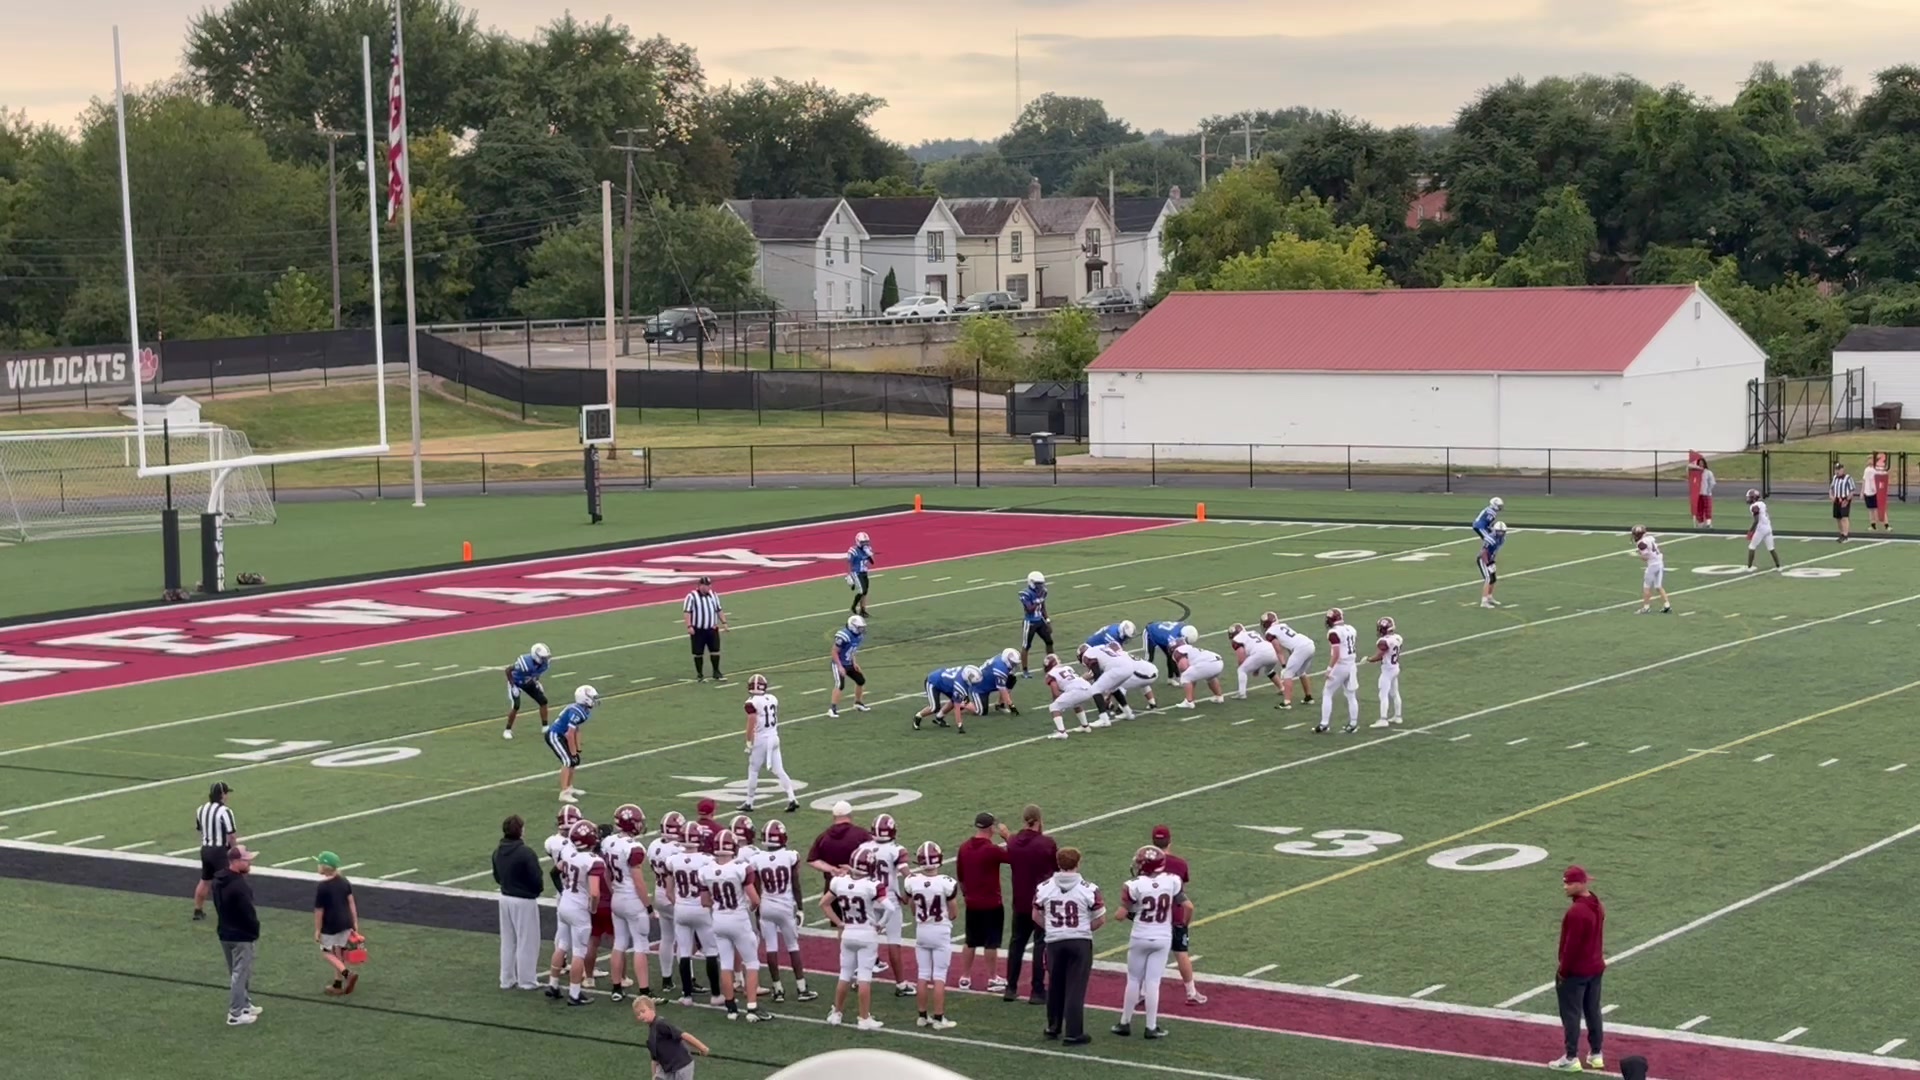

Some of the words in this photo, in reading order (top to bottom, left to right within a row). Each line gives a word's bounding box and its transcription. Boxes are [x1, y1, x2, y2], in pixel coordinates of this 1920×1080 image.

[6, 353, 126, 389] WILDCATS
[764, 704, 777, 728] 13
[675, 870, 702, 898] 89
[761, 865, 789, 894] 80
[712, 881, 738, 910] 40
[838, 895, 867, 924] 23
[913, 893, 943, 922] 34
[1140, 893, 1170, 923] 28
[1050, 900, 1079, 928] 58
